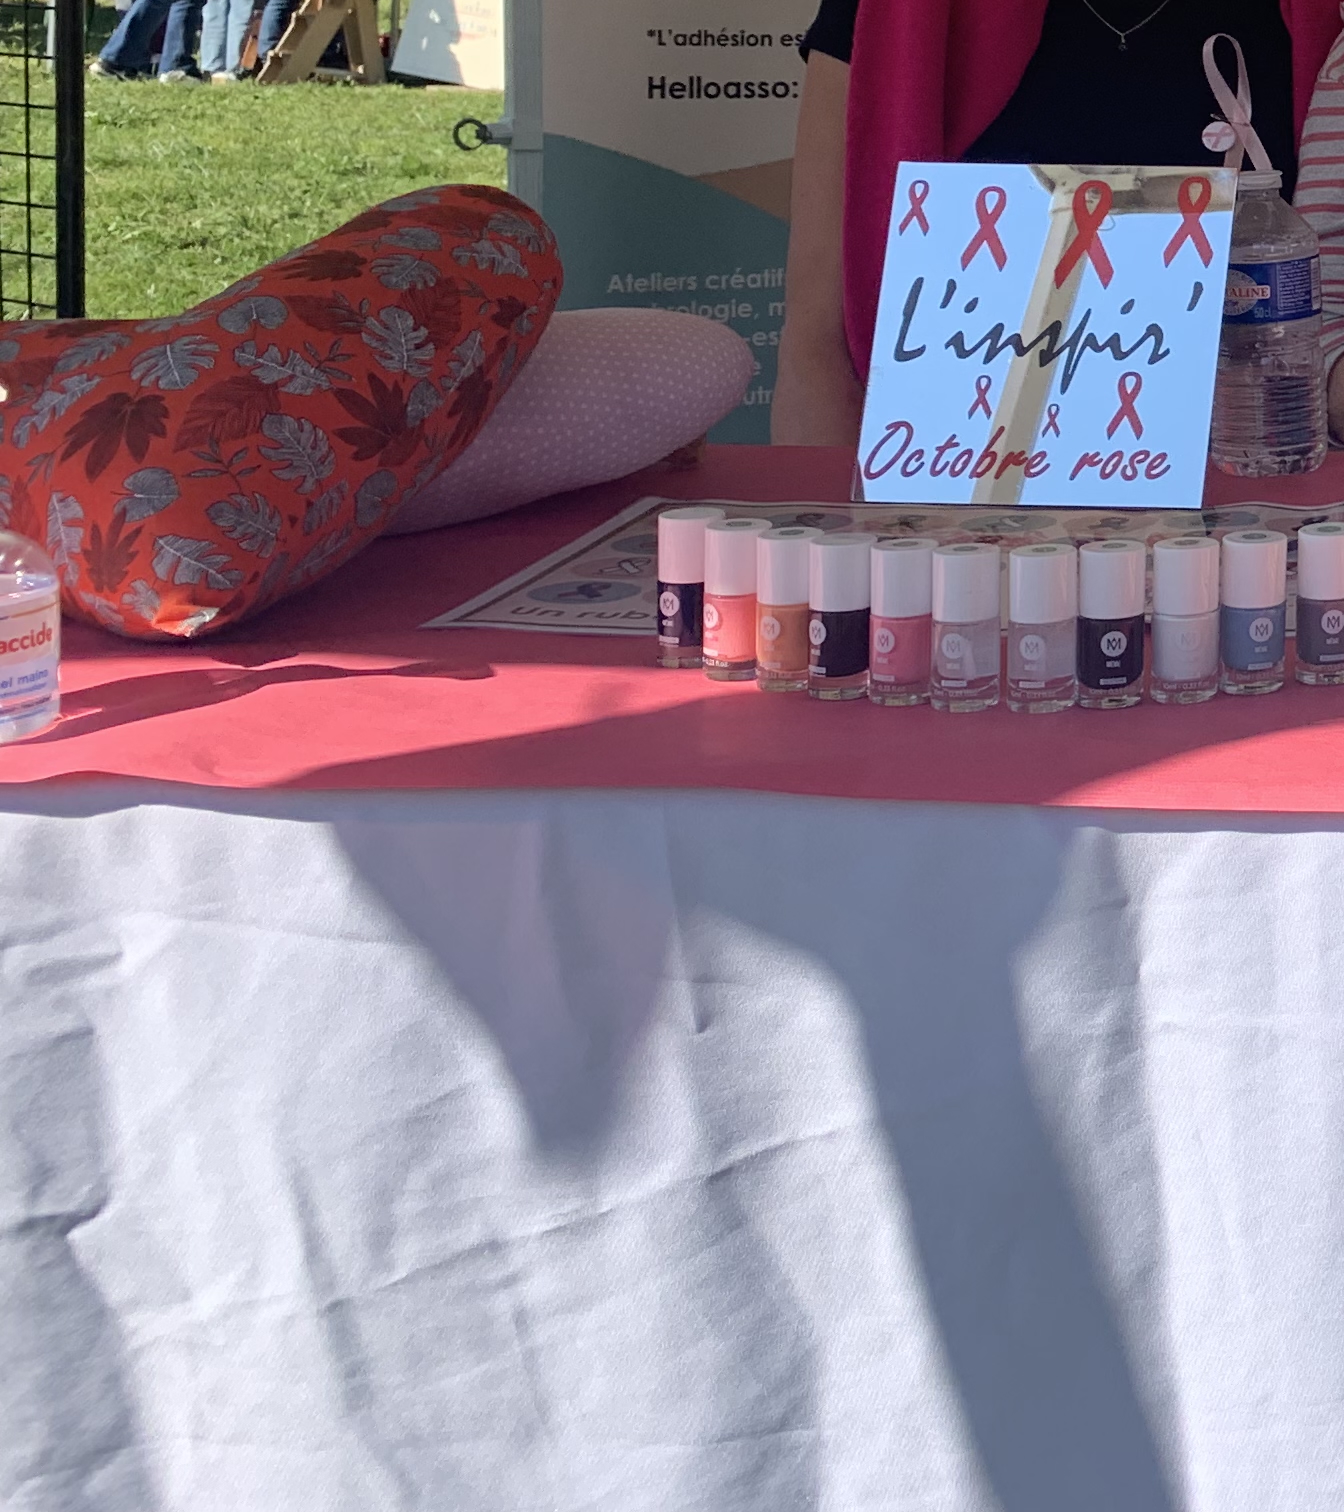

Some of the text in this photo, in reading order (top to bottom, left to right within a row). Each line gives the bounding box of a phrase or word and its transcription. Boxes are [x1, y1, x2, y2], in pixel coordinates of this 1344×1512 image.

[780, 32, 804, 48] es
[647, 75, 799, 100] Helloasso:
[606, 267, 784, 294] Ateliers créatif
[1226, 288, 1269, 298] ALINE
[863, 420, 1171, 481] Octobre rose
[577, 610, 650, 619] rub
[0, 622, 53, 655] accide
